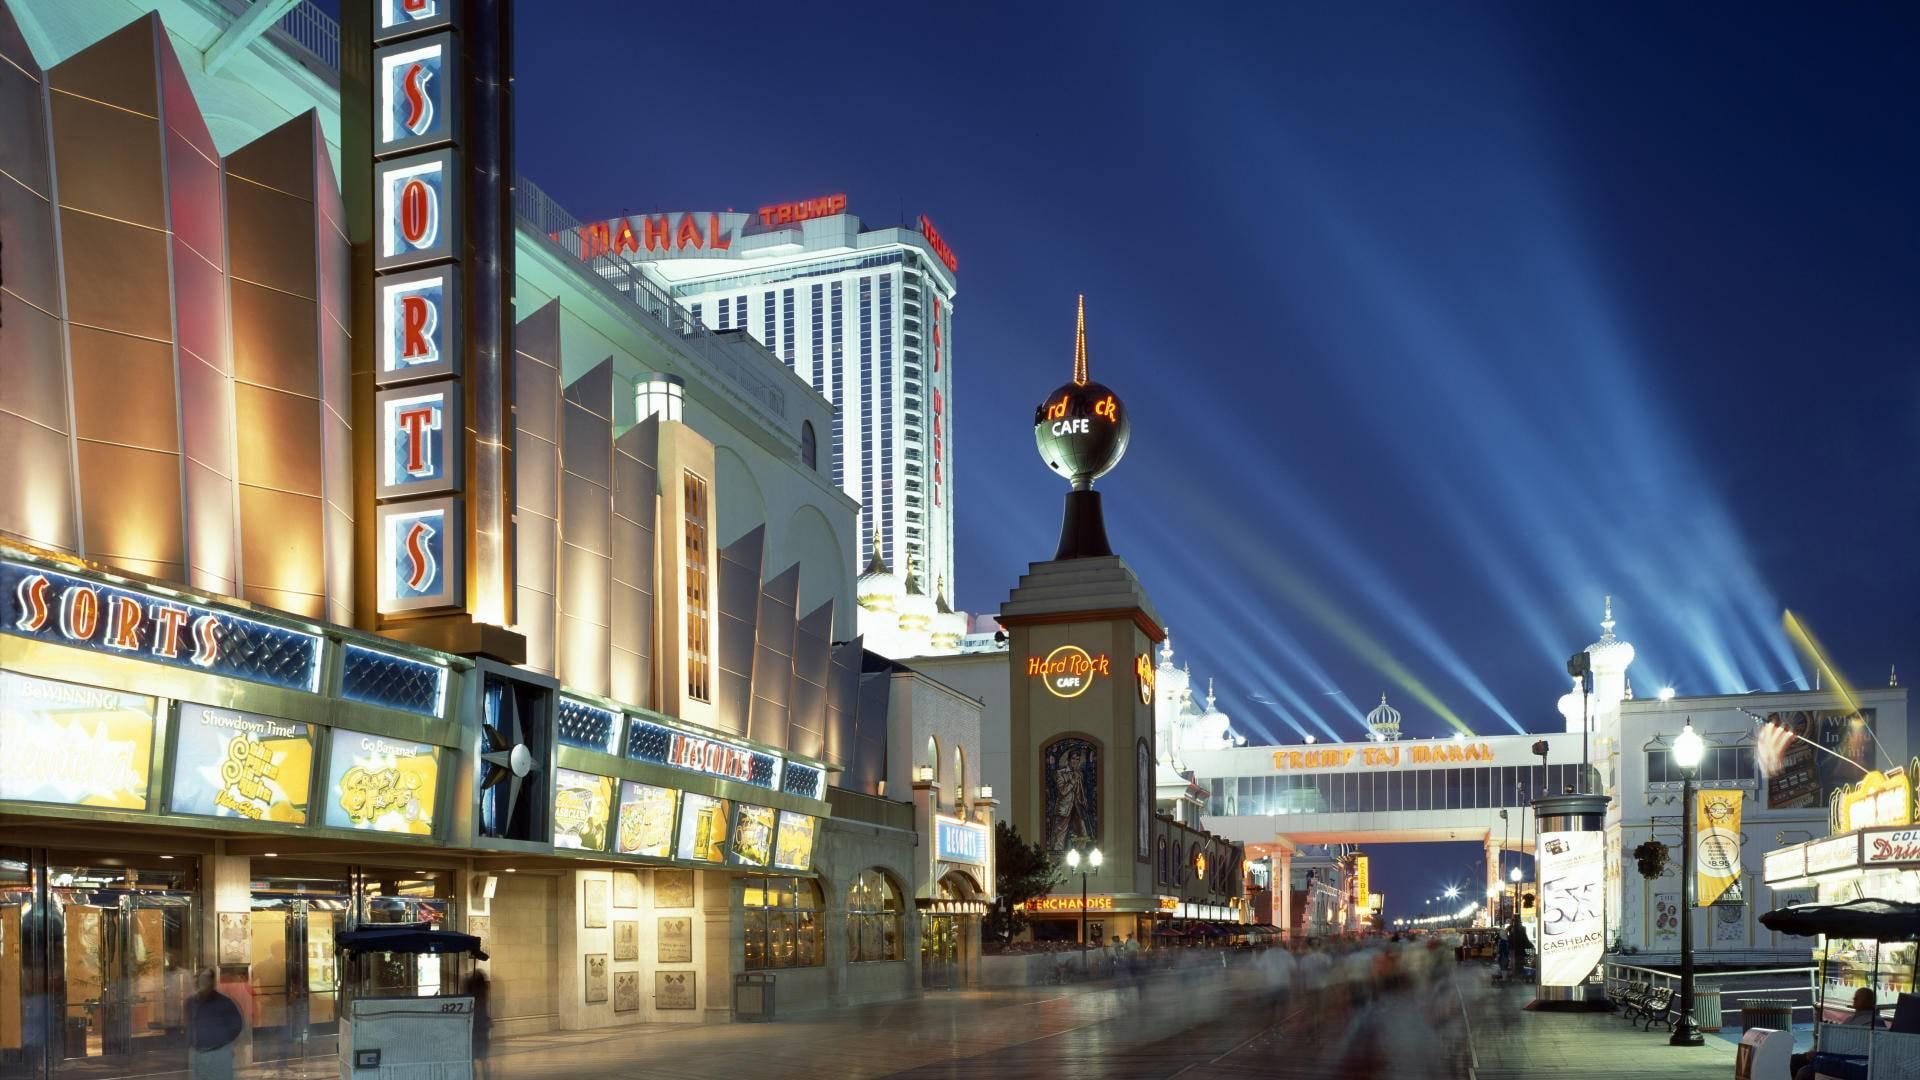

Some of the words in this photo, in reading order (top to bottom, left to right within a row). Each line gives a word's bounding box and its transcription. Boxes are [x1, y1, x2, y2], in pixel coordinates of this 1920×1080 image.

[759, 192, 846, 225] TRUMP
[579, 211, 732, 263] MAHAL
[398, 0, 444, 593] SORTS
[1051, 419, 1090, 437] CAFE
[16, 574, 221, 667] SORTS
[1029, 655, 1067, 675] Hard
[1069, 654, 1109, 676] Rock
[1056, 677, 1080, 688] CAFE
[200, 710, 264, 733] Showdown
[266, 720, 296, 738] Time!
[361, 738, 375, 752] Go
[377, 740, 417, 758] Bananas!
[1272, 748, 1355, 769] TRUMP
[1363, 746, 1401, 767] TAJ
[1412, 743, 1494, 763] MAHAL
[946, 827, 976, 857] RESORTS
[1543, 932, 1603, 951] CASHBACK
[441, 1003, 464, 1013] 827
